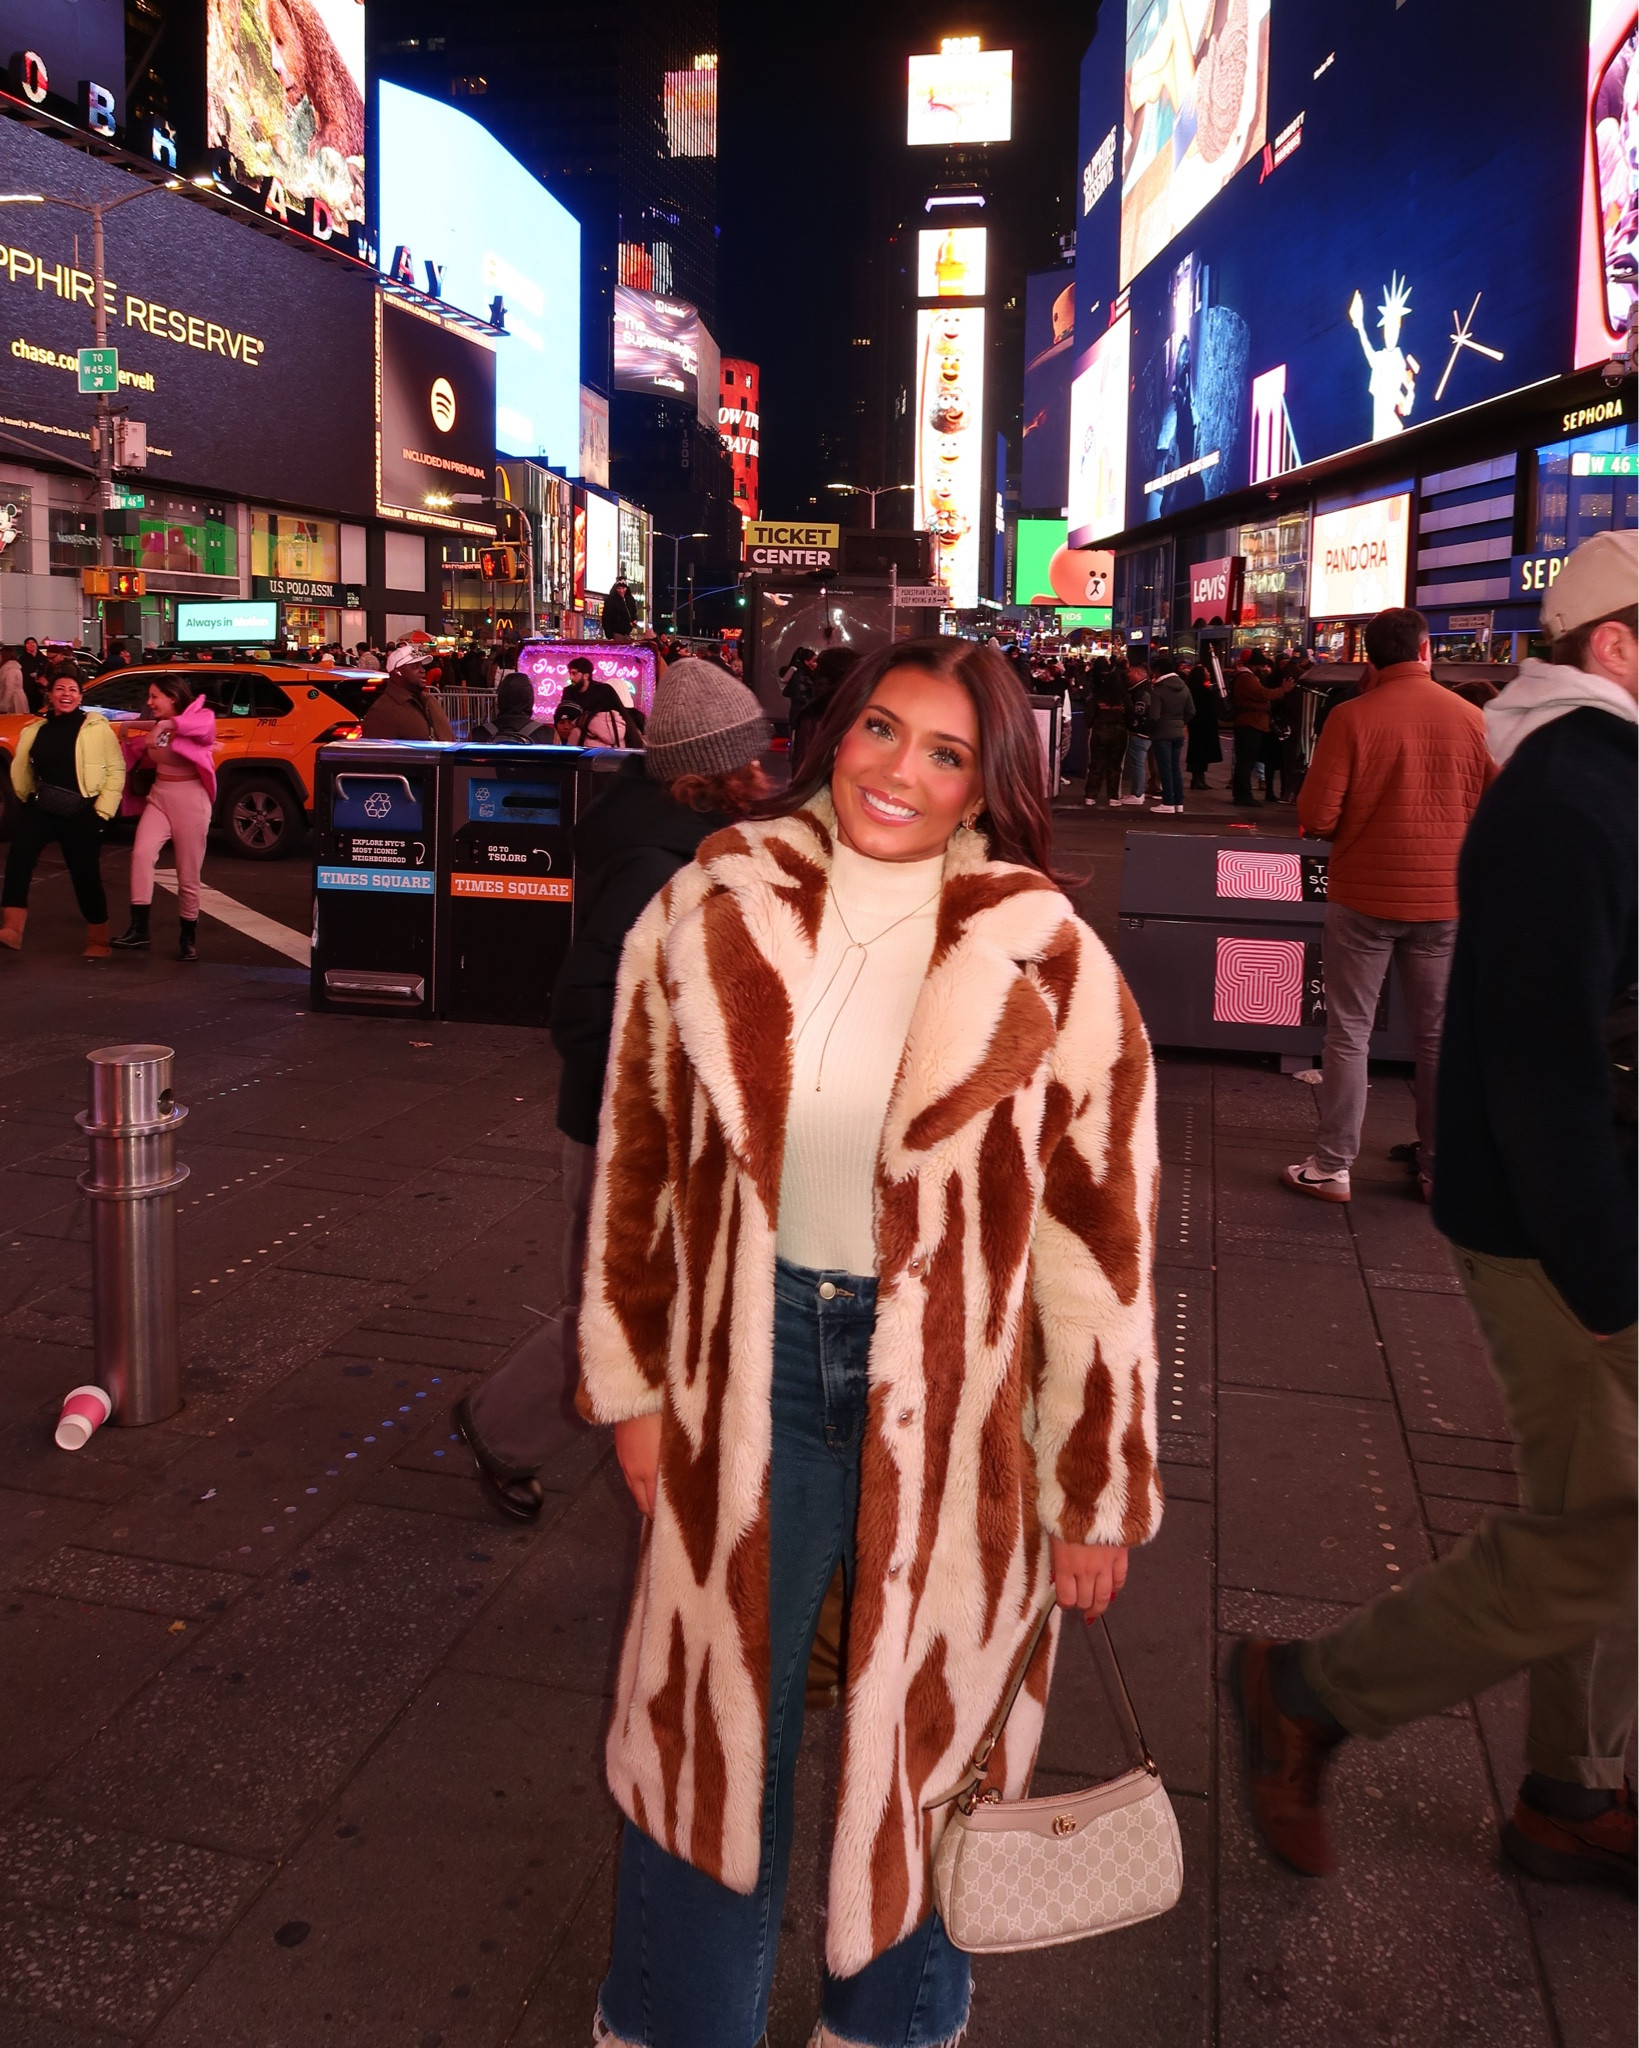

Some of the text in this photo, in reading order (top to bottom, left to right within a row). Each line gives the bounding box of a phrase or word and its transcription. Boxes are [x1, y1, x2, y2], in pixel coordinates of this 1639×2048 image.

[1083, 125, 1116, 194] SAPPHIRE
[1084, 154, 1114, 216] RESERVE
[92, 353, 103, 362] TO
[84, 365, 112, 374] W 45 St
[1563, 399, 1623, 432] SEPHORA
[402, 448, 442, 467] INCLUDED
[443, 459, 451, 471] IN
[1591, 458, 1605, 473] W
[1610, 456, 1630, 474] 46
[128, 497, 136, 506] 46
[754, 527, 831, 545] TICKET
[753, 549, 831, 566] CENTER
[1006, 526, 1014, 588] NOVEMBER
[1325, 540, 1388, 575] PANDORA
[1521, 556, 1569, 591] SEP
[270, 580, 334, 597] U.S. POLO ASSN.
[901, 588, 925, 596] PEDESTRIAN
[925, 588, 936, 596] FLOW
[186, 618, 221, 629] Always
[223, 617, 232, 626] in
[257, 719, 277, 727] 7P10
[352, 838, 384, 846] EXPLORE
[488, 845, 499, 853] GO
[352, 855, 406, 863] NEIGHBORHOOD
[488, 853, 527, 863] TSQ.ORG
[321, 872, 431, 890] TIMES SQUARE
[455, 879, 569, 898] TIMES SQUARE
